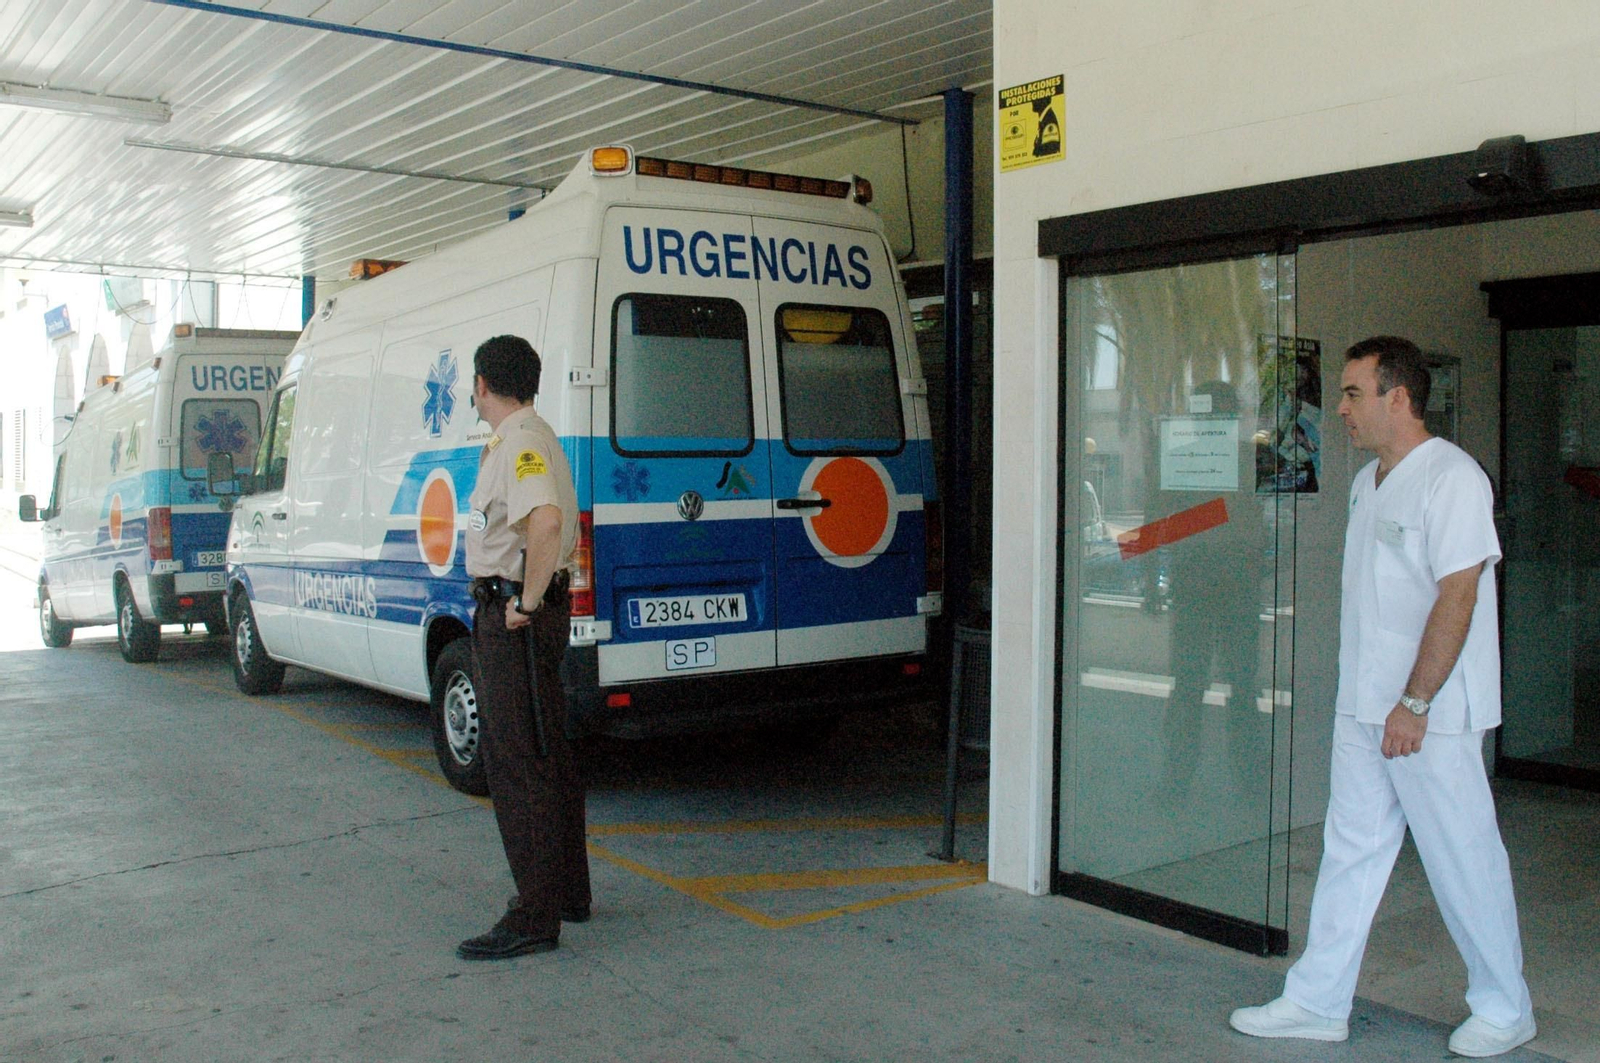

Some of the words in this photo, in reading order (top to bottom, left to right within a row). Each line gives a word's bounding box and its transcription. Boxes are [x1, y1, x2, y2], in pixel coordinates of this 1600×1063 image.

[1001, 76, 1061, 99] INSTALACIONES
[1006, 86, 1056, 106] PROTEGIDAS
[623, 226, 872, 290] URGENCIAS
[200, 553, 226, 565] 328
[296, 571, 378, 619] URGENCIAS
[645, 600, 694, 623] 2384
[704, 597, 739, 619] CKW
[673, 641, 709, 665] SP
